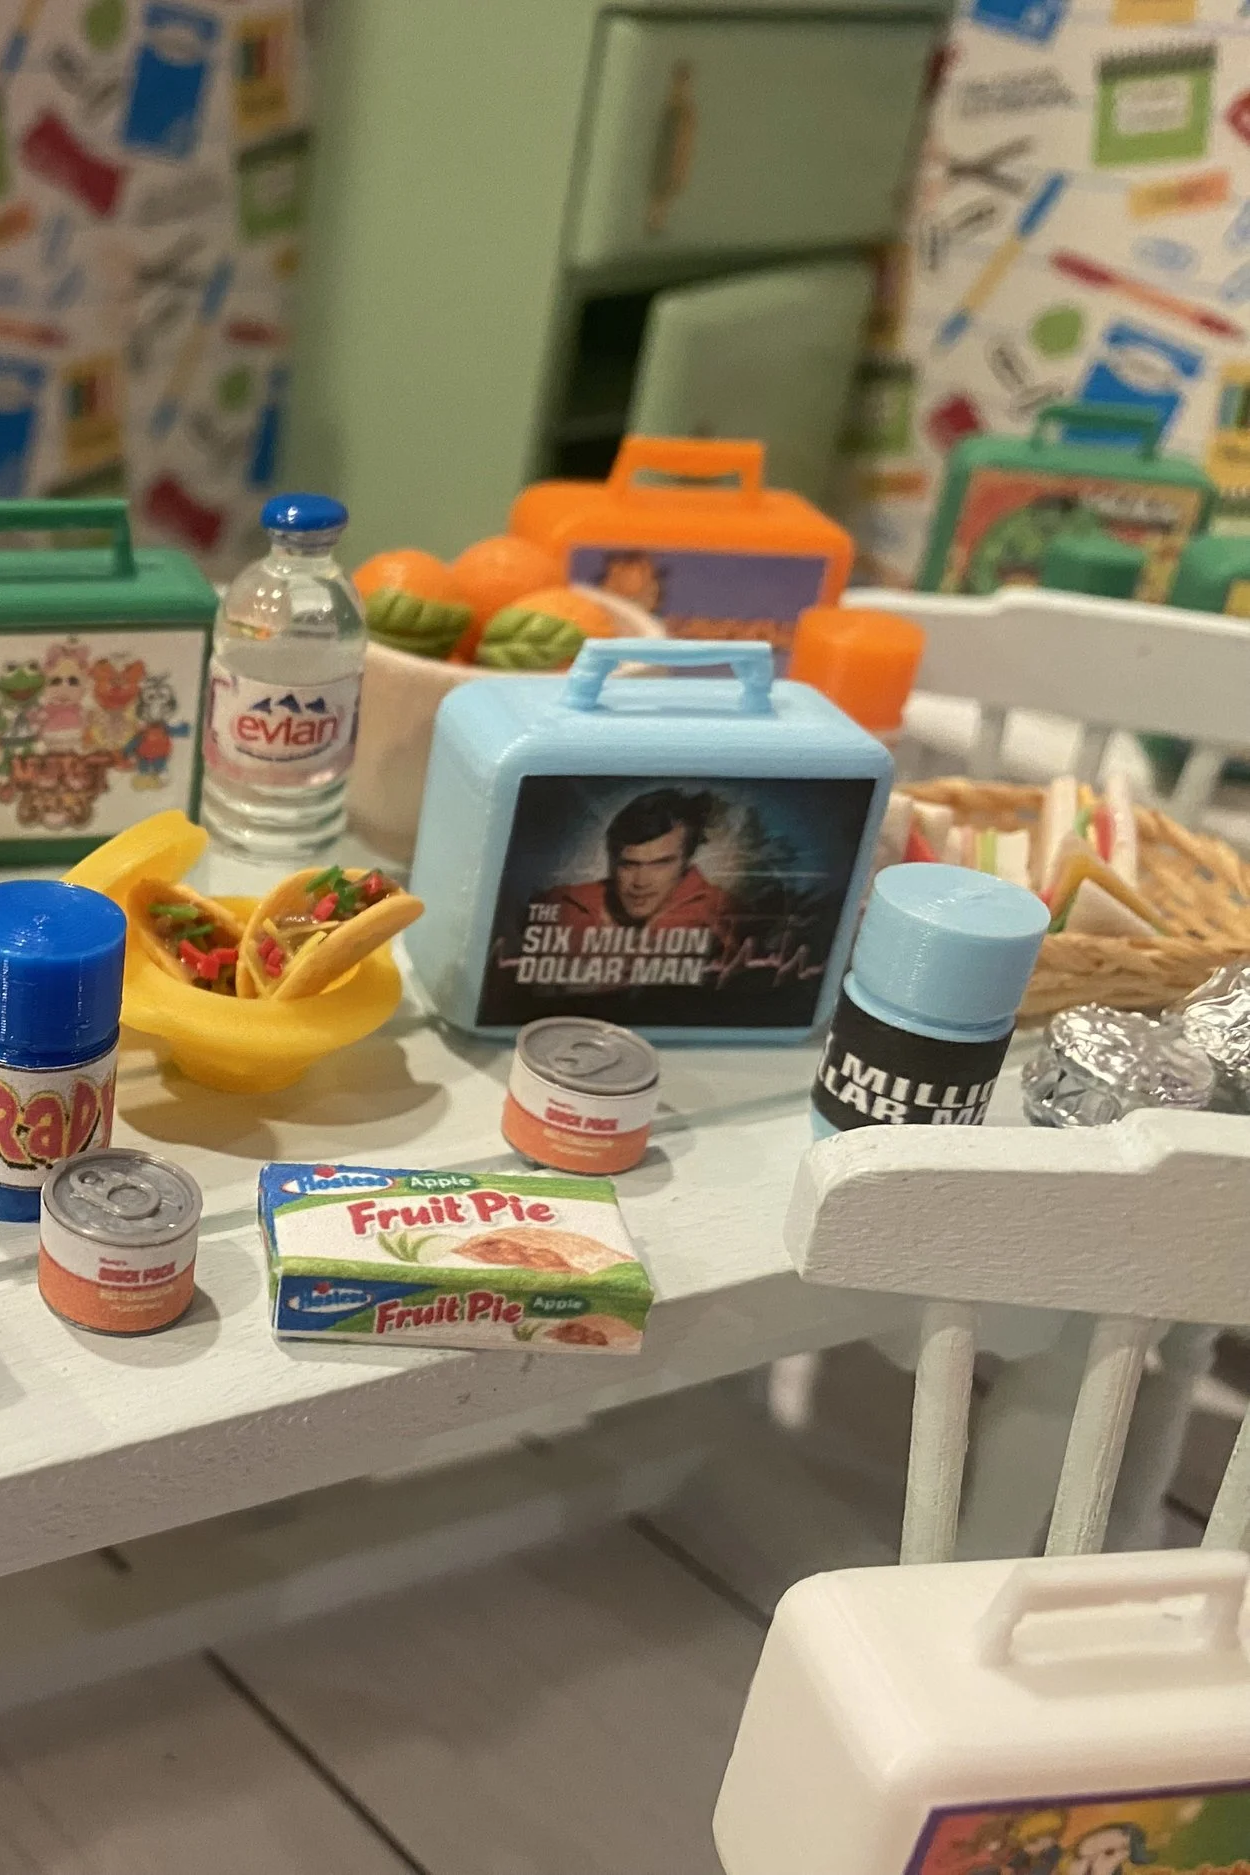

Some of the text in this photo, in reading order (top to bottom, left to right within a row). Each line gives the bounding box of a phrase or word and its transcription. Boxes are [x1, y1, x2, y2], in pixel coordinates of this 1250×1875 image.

[236, 713, 339, 746] evian
[527, 903, 561, 922] THE
[522, 925, 711, 954] SIX MILLION
[516, 955, 705, 985] DOLLAR MAN
[408, 1174, 472, 1190] Apple
[346, 1190, 557, 1236] Fruit Pie
[375, 1290, 525, 1335] Fruit Pie
[532, 1296, 584, 1312] Apple
